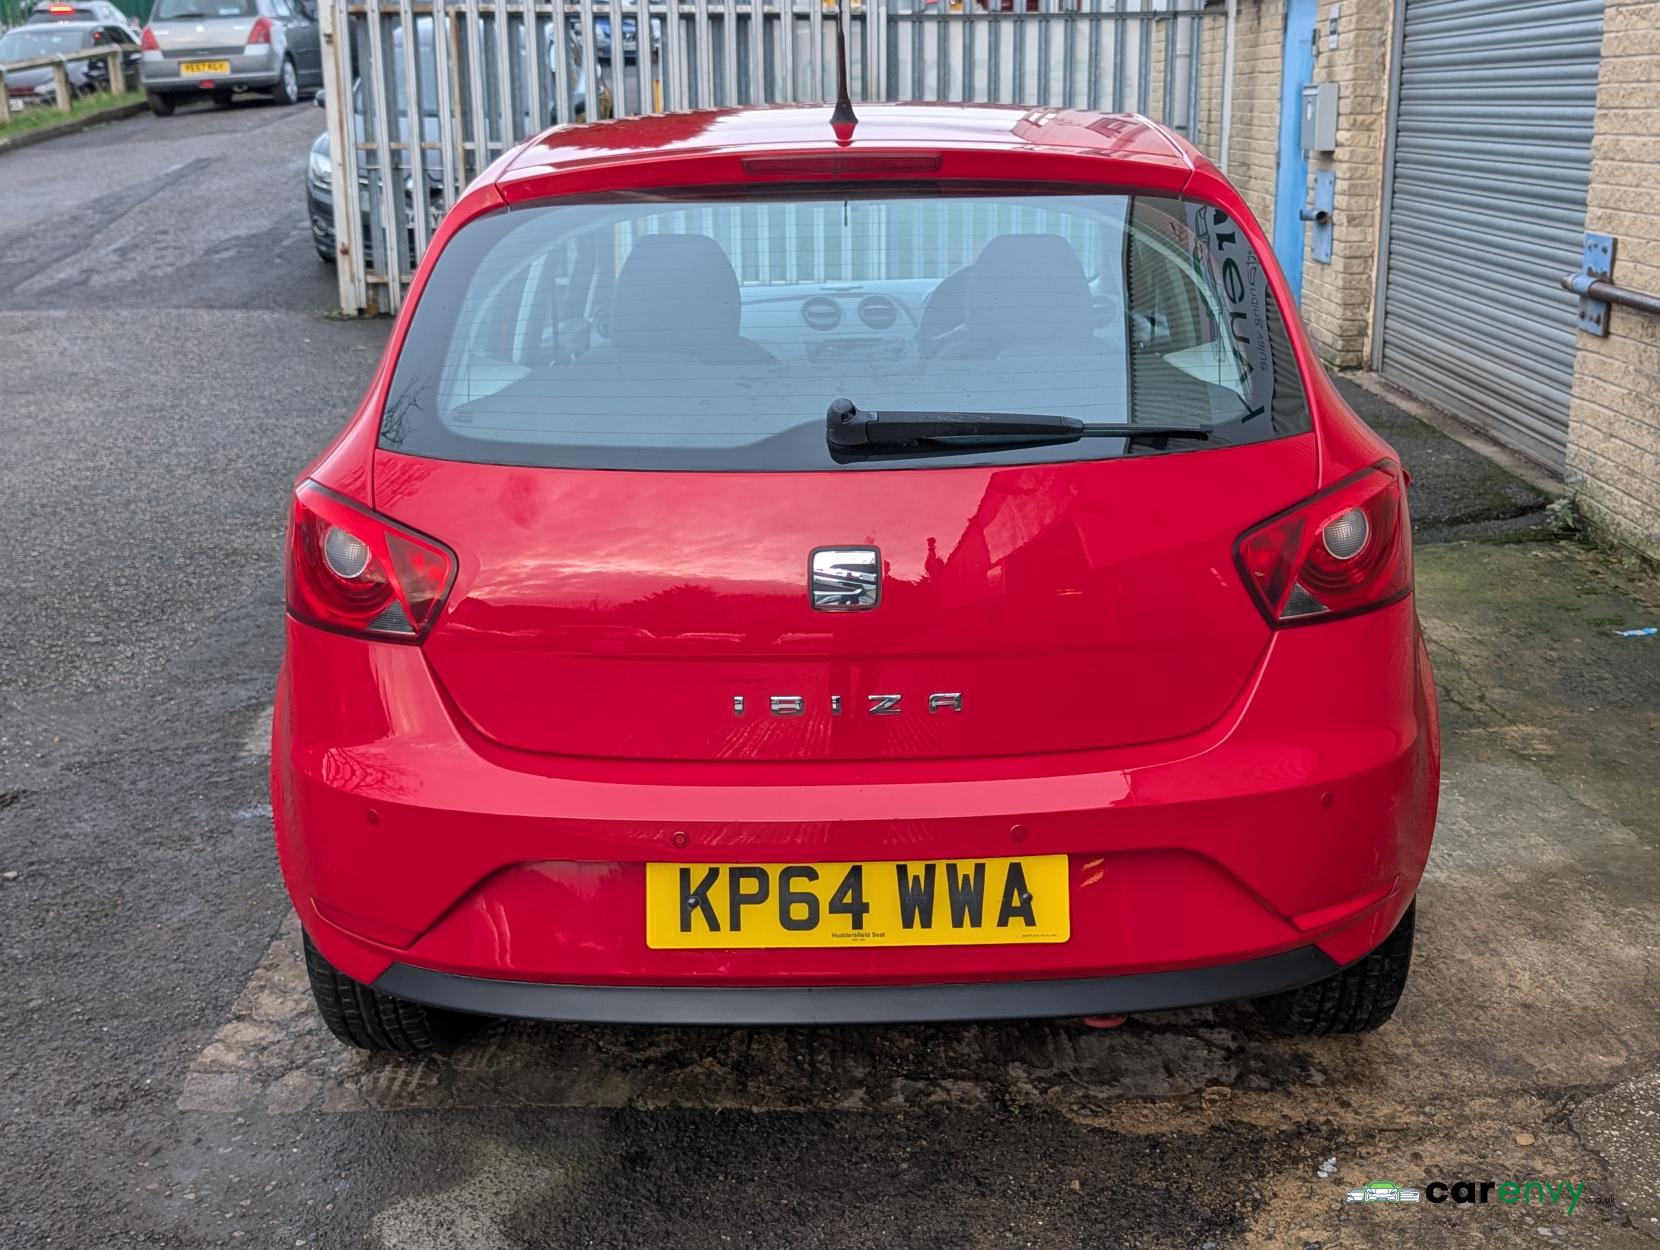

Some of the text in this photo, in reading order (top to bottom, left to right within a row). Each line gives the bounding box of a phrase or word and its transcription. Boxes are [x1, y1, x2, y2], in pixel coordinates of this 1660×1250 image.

[733, 692, 962, 717] IBIZA
[678, 862, 1037, 932] KP64 WWA
